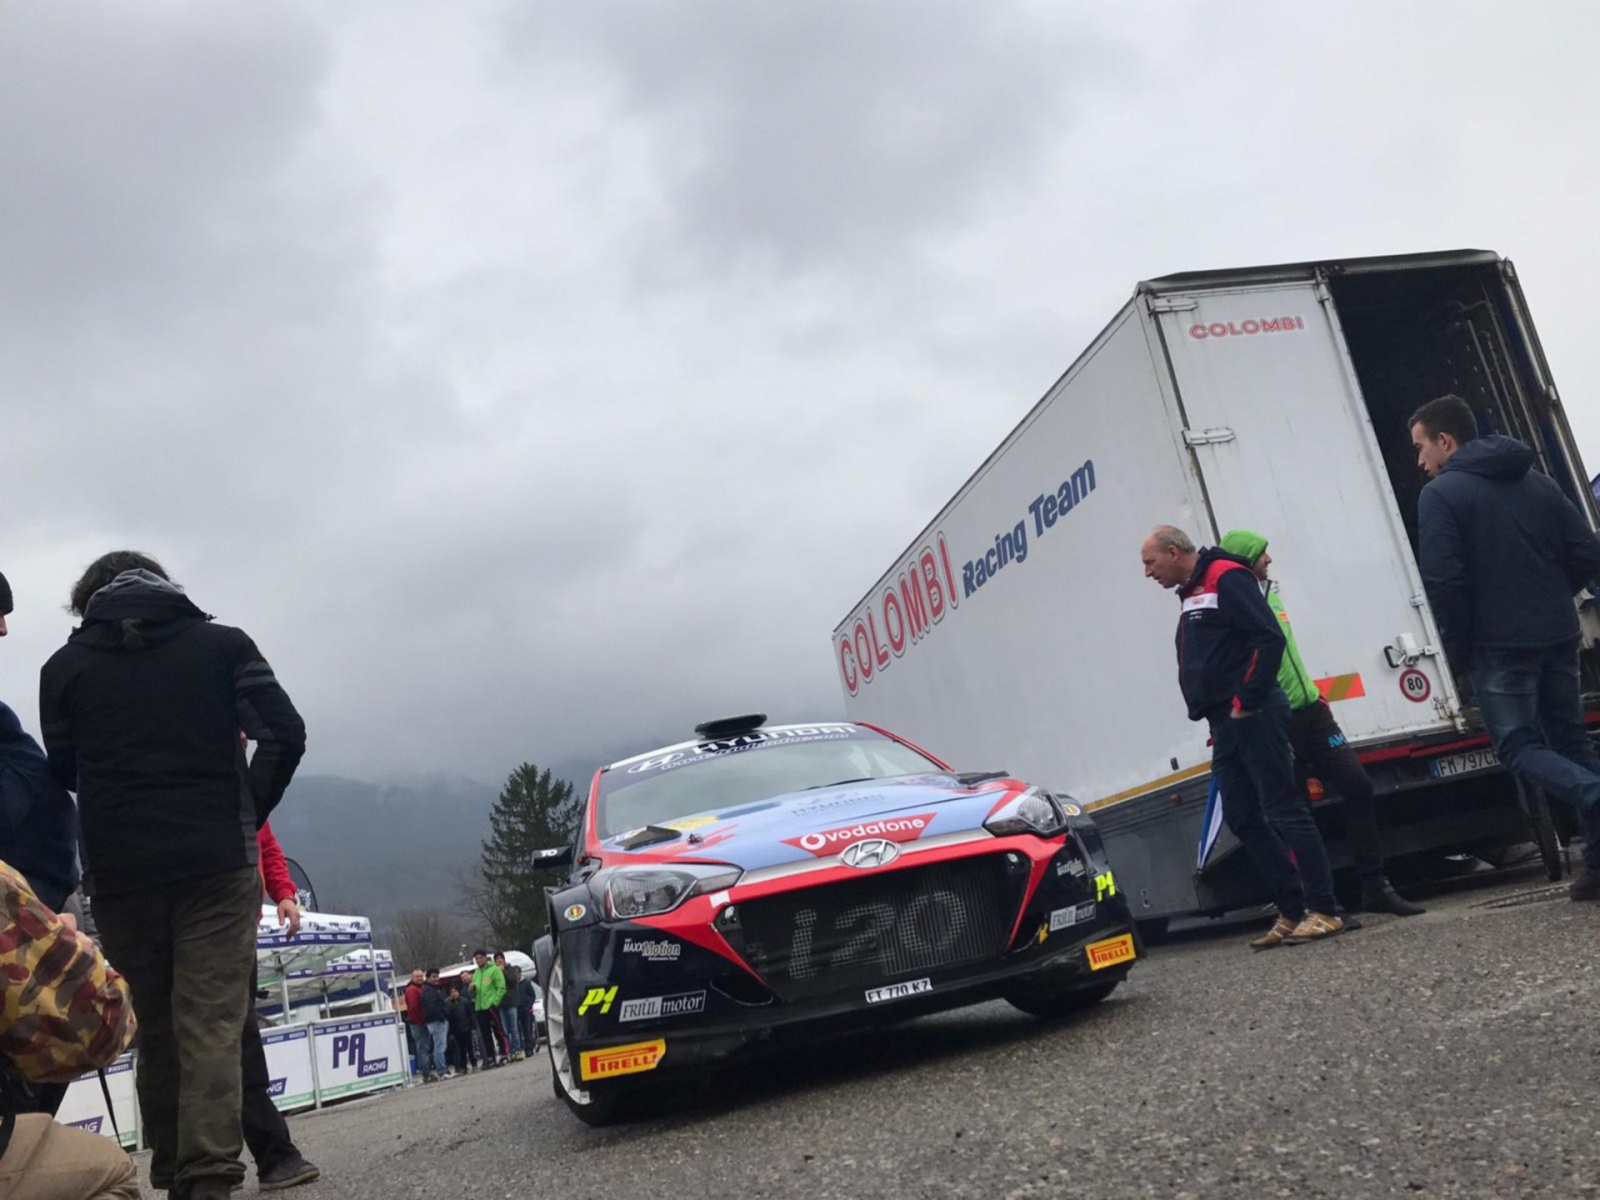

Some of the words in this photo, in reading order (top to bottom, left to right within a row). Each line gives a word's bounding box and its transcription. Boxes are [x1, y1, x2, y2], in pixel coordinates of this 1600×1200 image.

[1189, 315, 1305, 340] COLOMBI
[839, 531, 958, 696] COLOMBI
[962, 519, 1028, 599] Racing
[1028, 459, 1096, 538] Team
[1406, 676, 1424, 692] 80
[693, 727, 857, 755] HYUNDAI
[826, 818, 925, 842] vodafone
[1090, 940, 1130, 964] PIRELLI
[578, 985, 619, 1016] P1
[363, 1060, 387, 1073] RACING
